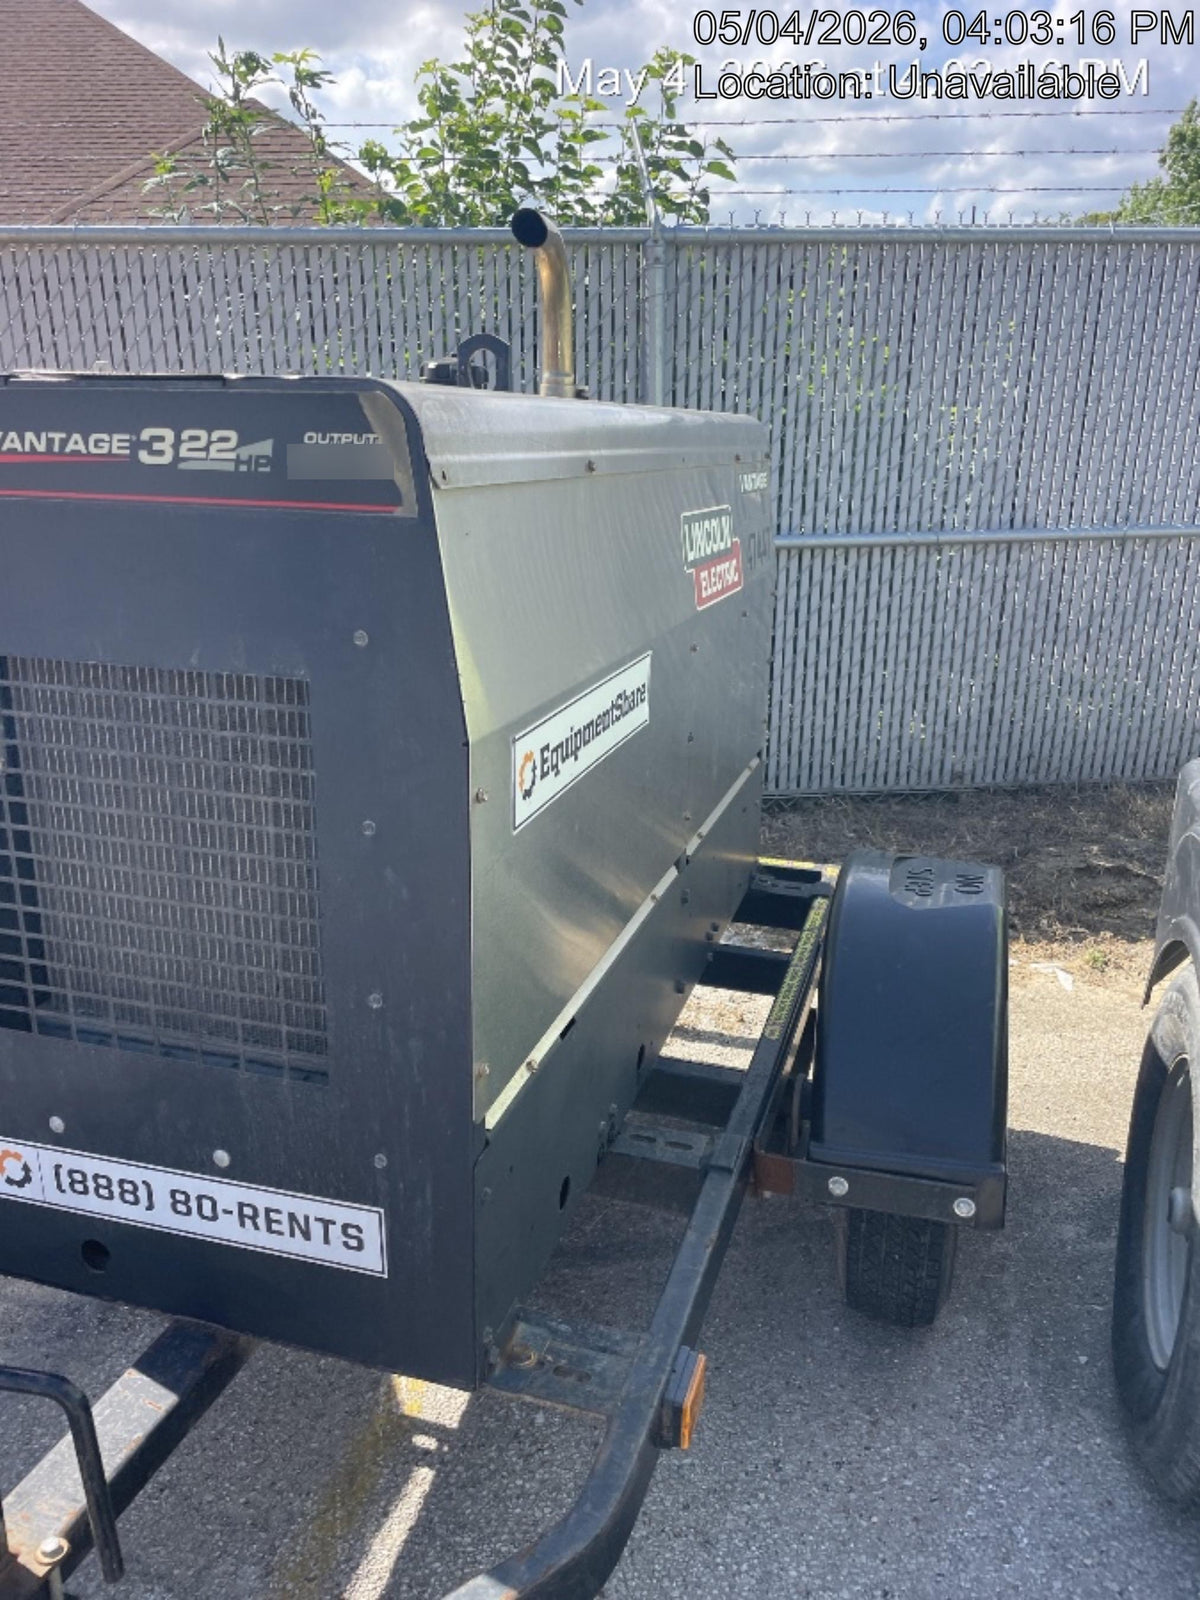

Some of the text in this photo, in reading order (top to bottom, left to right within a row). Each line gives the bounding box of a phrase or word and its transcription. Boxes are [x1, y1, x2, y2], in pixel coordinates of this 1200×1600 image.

[0, 431, 130, 454] ANTAGE
[138, 427, 238, 464] 322
[684, 515, 732, 563] LINCOLN
[700, 558, 739, 598] ELECTRIC
[539, 682, 647, 782] EquipmentShare
[54, 1163, 366, 1252] (888) 80-RENTS
